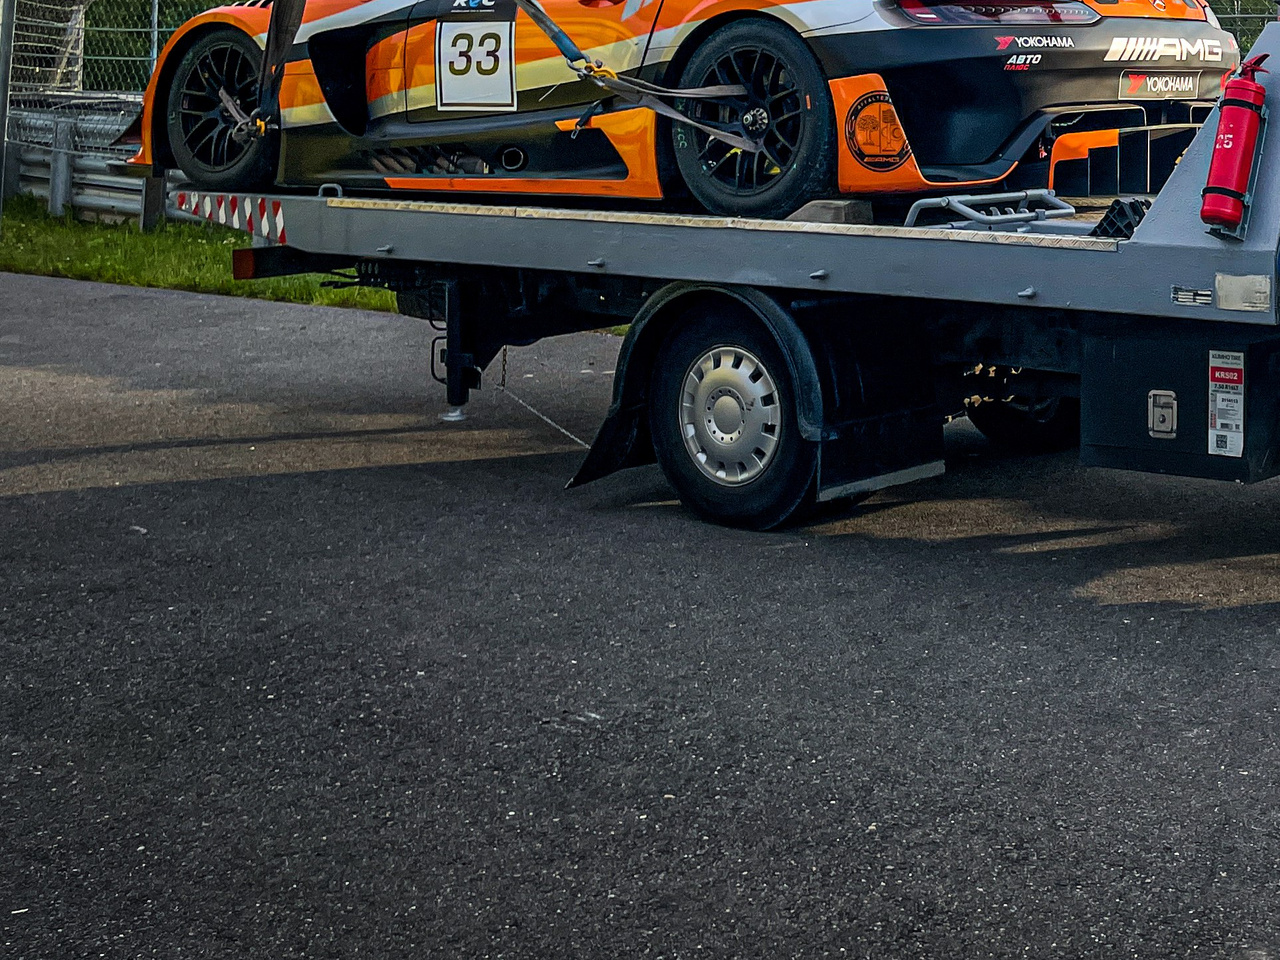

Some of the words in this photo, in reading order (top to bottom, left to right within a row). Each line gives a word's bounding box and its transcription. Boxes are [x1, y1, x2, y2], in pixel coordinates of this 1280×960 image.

[1014, 36, 1075, 49] YOKOHAMA
[1157, 37, 1224, 62] AMG
[448, 32, 502, 76] 33
[1006, 54, 1042, 64] АВТО
[1146, 76, 1194, 93] YOKOHAMA
